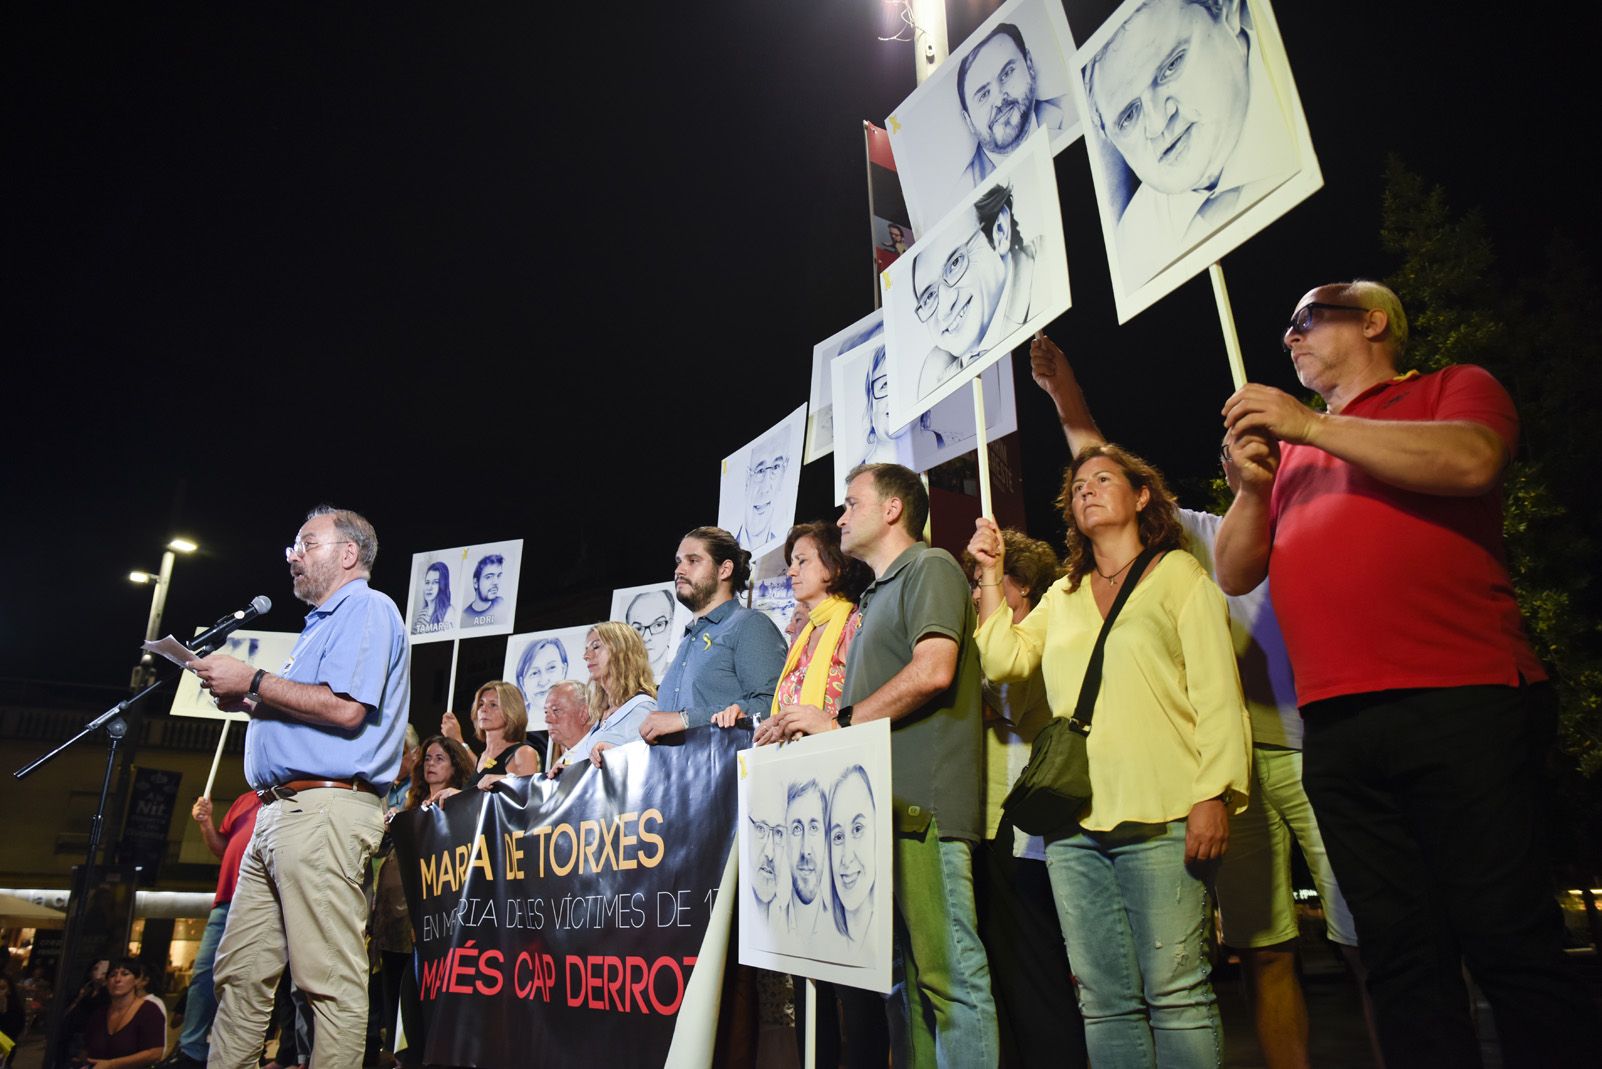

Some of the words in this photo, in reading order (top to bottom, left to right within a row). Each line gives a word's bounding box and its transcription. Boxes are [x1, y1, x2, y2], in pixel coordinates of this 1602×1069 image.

[504, 831, 525, 881] DE
[535, 808, 665, 878] TORXES
[423, 913, 440, 942] EN
[552, 889, 646, 930] VÍCTIMES
[657, 890, 692, 928] DE
[513, 950, 556, 1003] CAP
[566, 954, 699, 1017] DERRO
